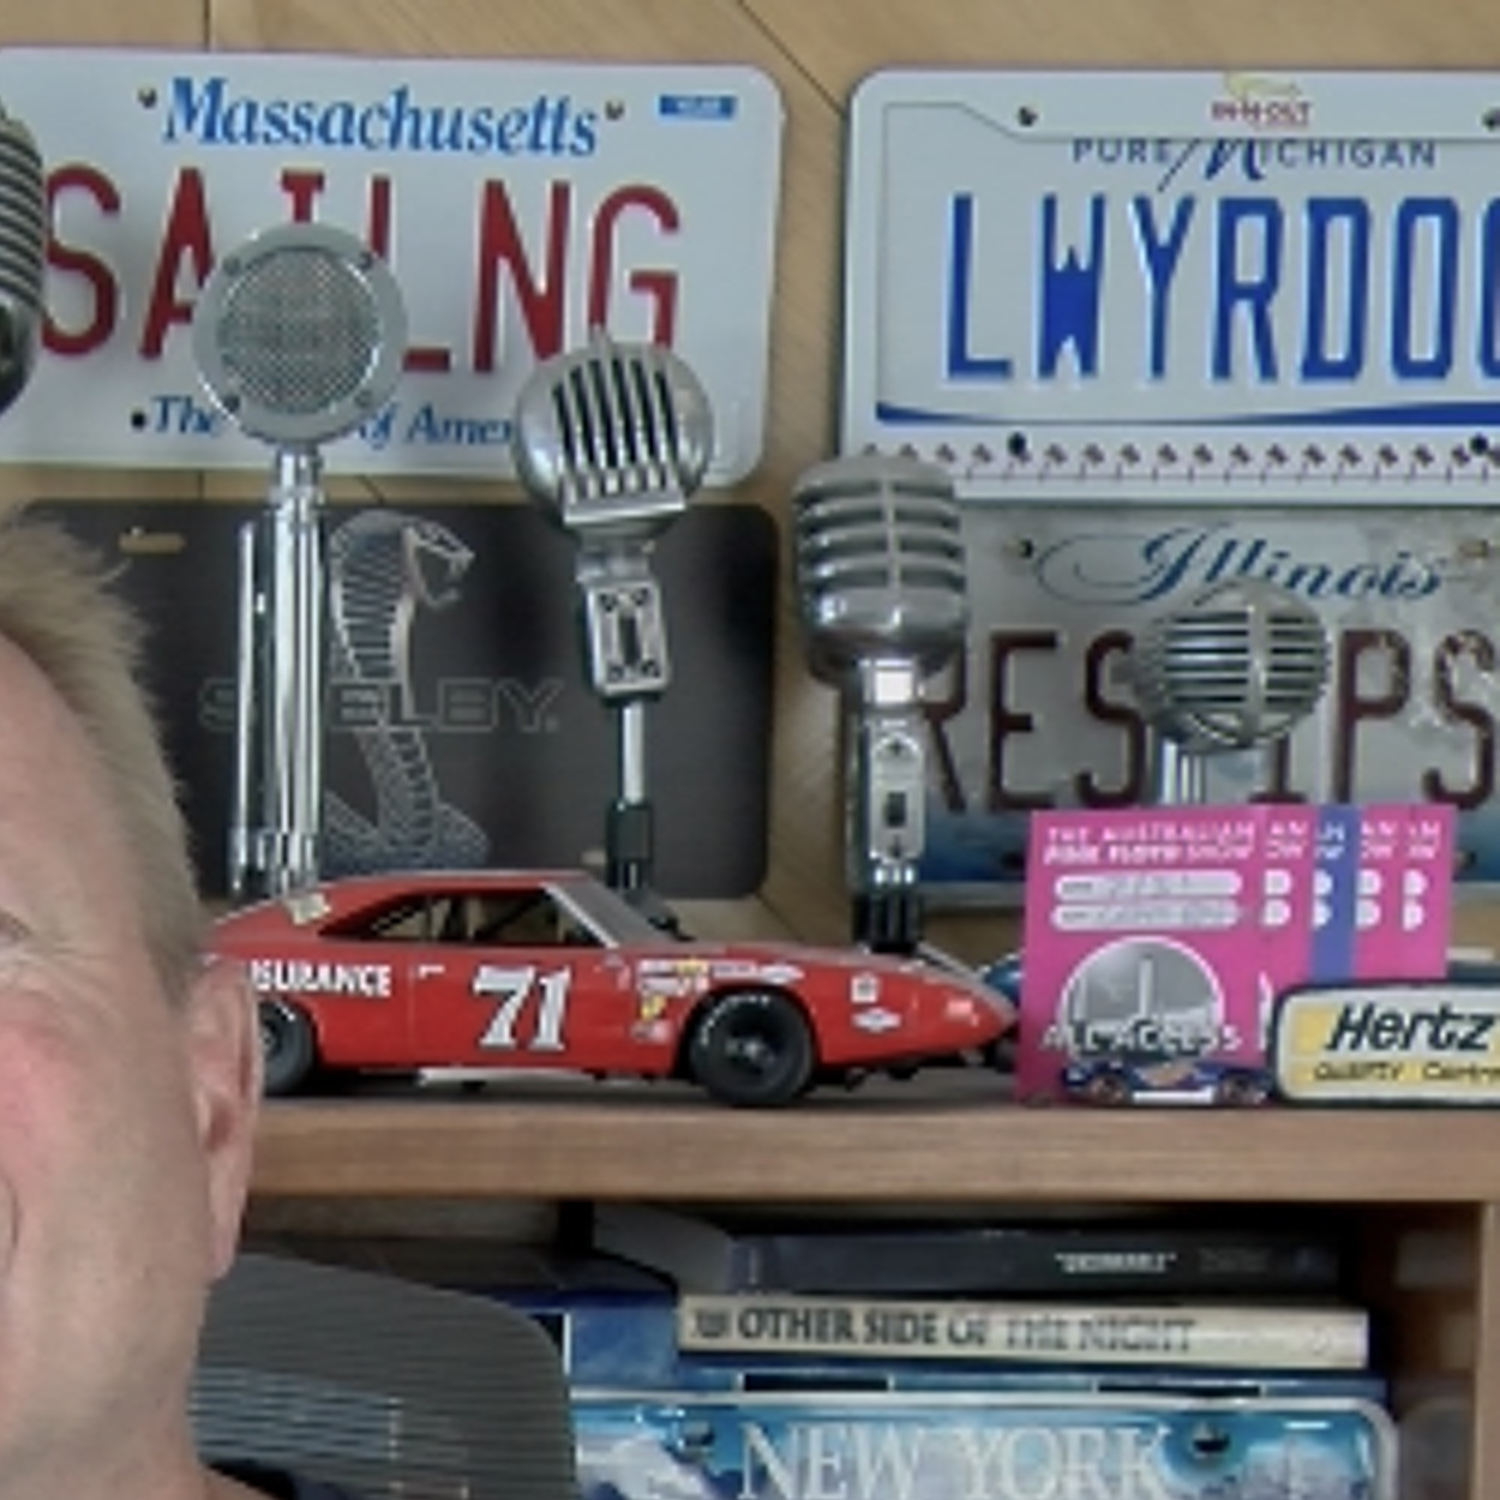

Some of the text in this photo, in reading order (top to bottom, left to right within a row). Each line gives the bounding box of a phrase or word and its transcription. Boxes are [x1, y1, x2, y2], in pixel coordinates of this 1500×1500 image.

[163, 75, 598, 157] Massachusetts
[1072, 137, 1436, 182] PURE MICHIGAN
[40, 164, 680, 374] SALNG
[946, 192, 1500, 381] LWYRDO
[406, 404, 513, 446] Amer
[1040, 523, 1448, 604] Illinois
[199, 677, 564, 734] SELBY
[471, 963, 573, 1052] 71
[1324, 1001, 1496, 1052] Hertz
[738, 1306, 855, 1343] OTHER
[862, 1307, 938, 1345] SIDE
[947, 1310, 987, 1347] OF
[1005, 1315, 1070, 1350] THE
[1079, 1317, 1196, 1353] NIGHT
